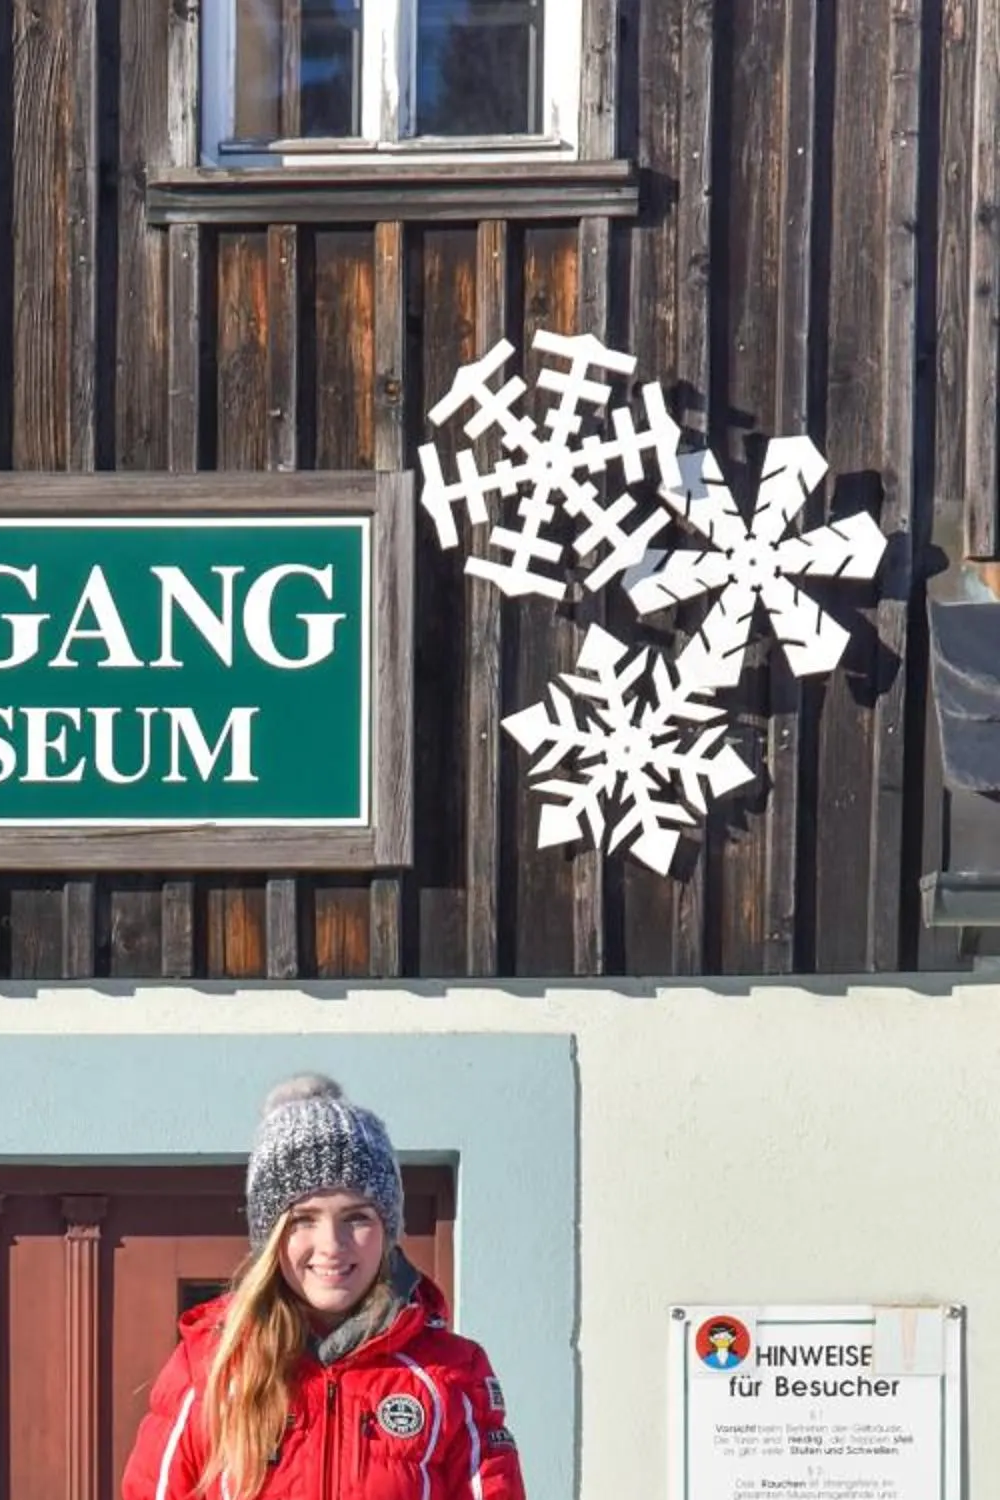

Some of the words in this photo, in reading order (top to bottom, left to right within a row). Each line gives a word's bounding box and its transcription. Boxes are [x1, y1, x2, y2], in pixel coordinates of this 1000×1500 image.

[755, 1345, 873, 1367] HINWEISE
[729, 1375, 762, 1397] für
[775, 1375, 900, 1397] Besucher
